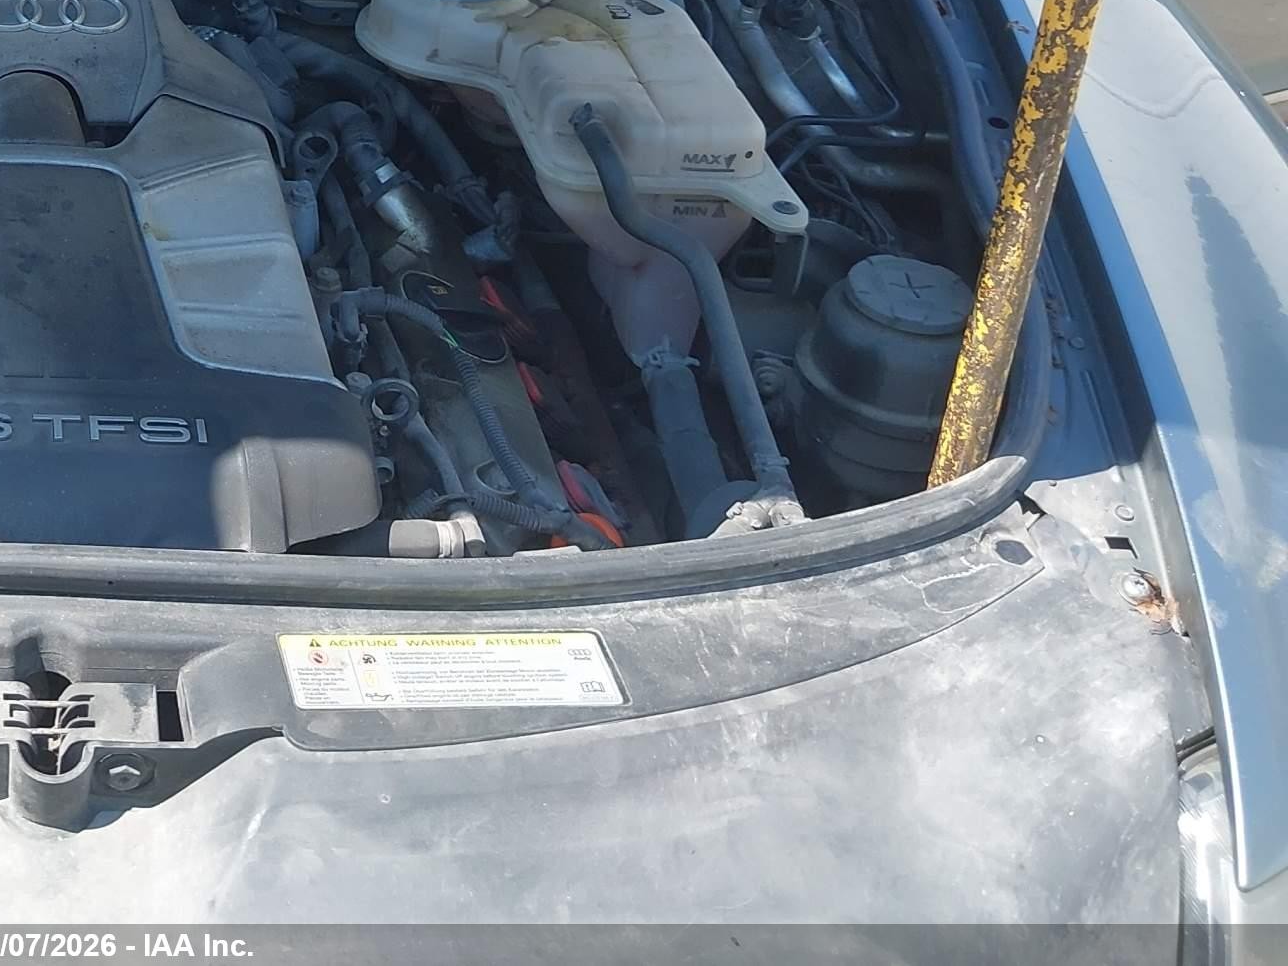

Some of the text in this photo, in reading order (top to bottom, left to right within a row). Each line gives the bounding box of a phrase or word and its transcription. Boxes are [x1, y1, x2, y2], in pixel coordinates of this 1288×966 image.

[682, 153, 722, 165] MAX
[672, 205, 709, 217] MIN
[31, 412, 209, 444] TFSI
[329, 637, 562, 647] ACHTUNG WARNING ATTENTION
